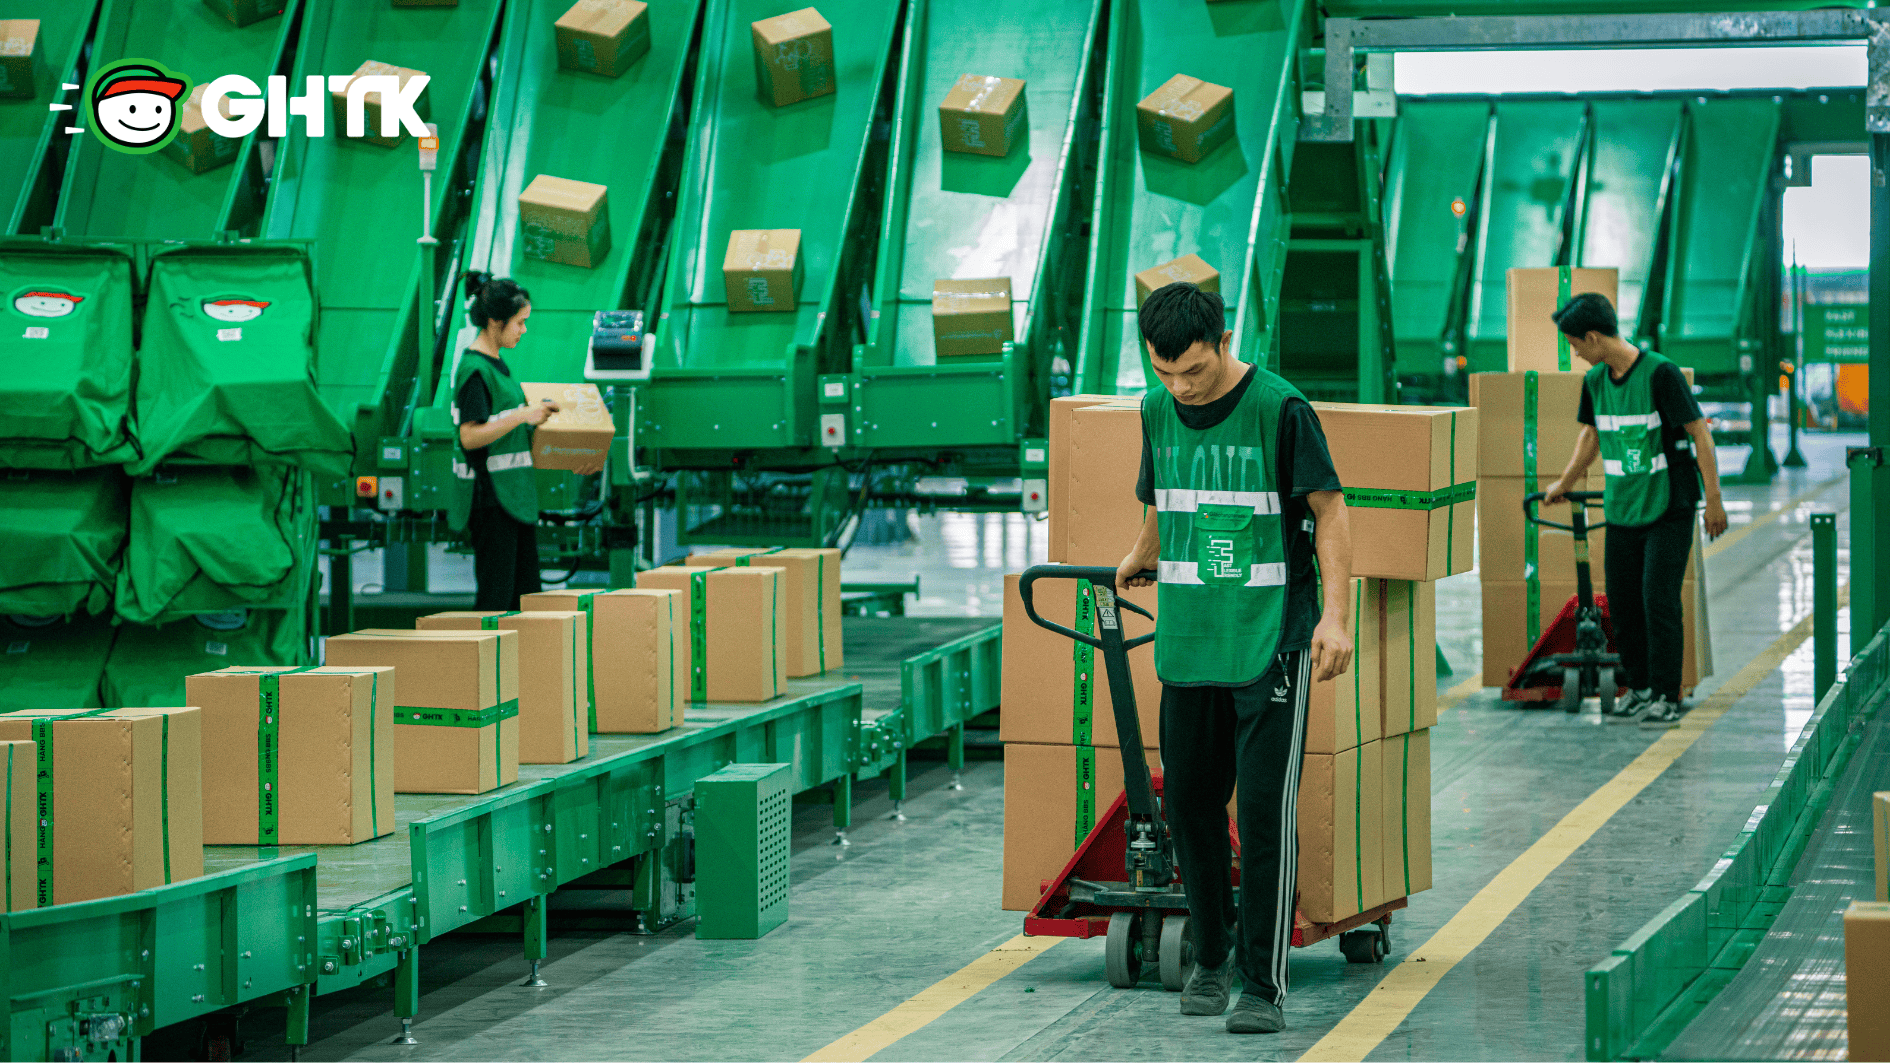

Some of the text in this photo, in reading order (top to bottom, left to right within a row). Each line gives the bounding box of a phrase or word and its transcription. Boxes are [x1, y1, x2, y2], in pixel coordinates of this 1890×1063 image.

[265, 691, 273, 714] GHTK
[1080, 682, 1088, 706] GHTK
[422, 713, 443, 721] GHTK
[1082, 757, 1090, 780] GHTK
[39, 791, 48, 817] GHTK
[39, 878, 47, 904] GHTK
